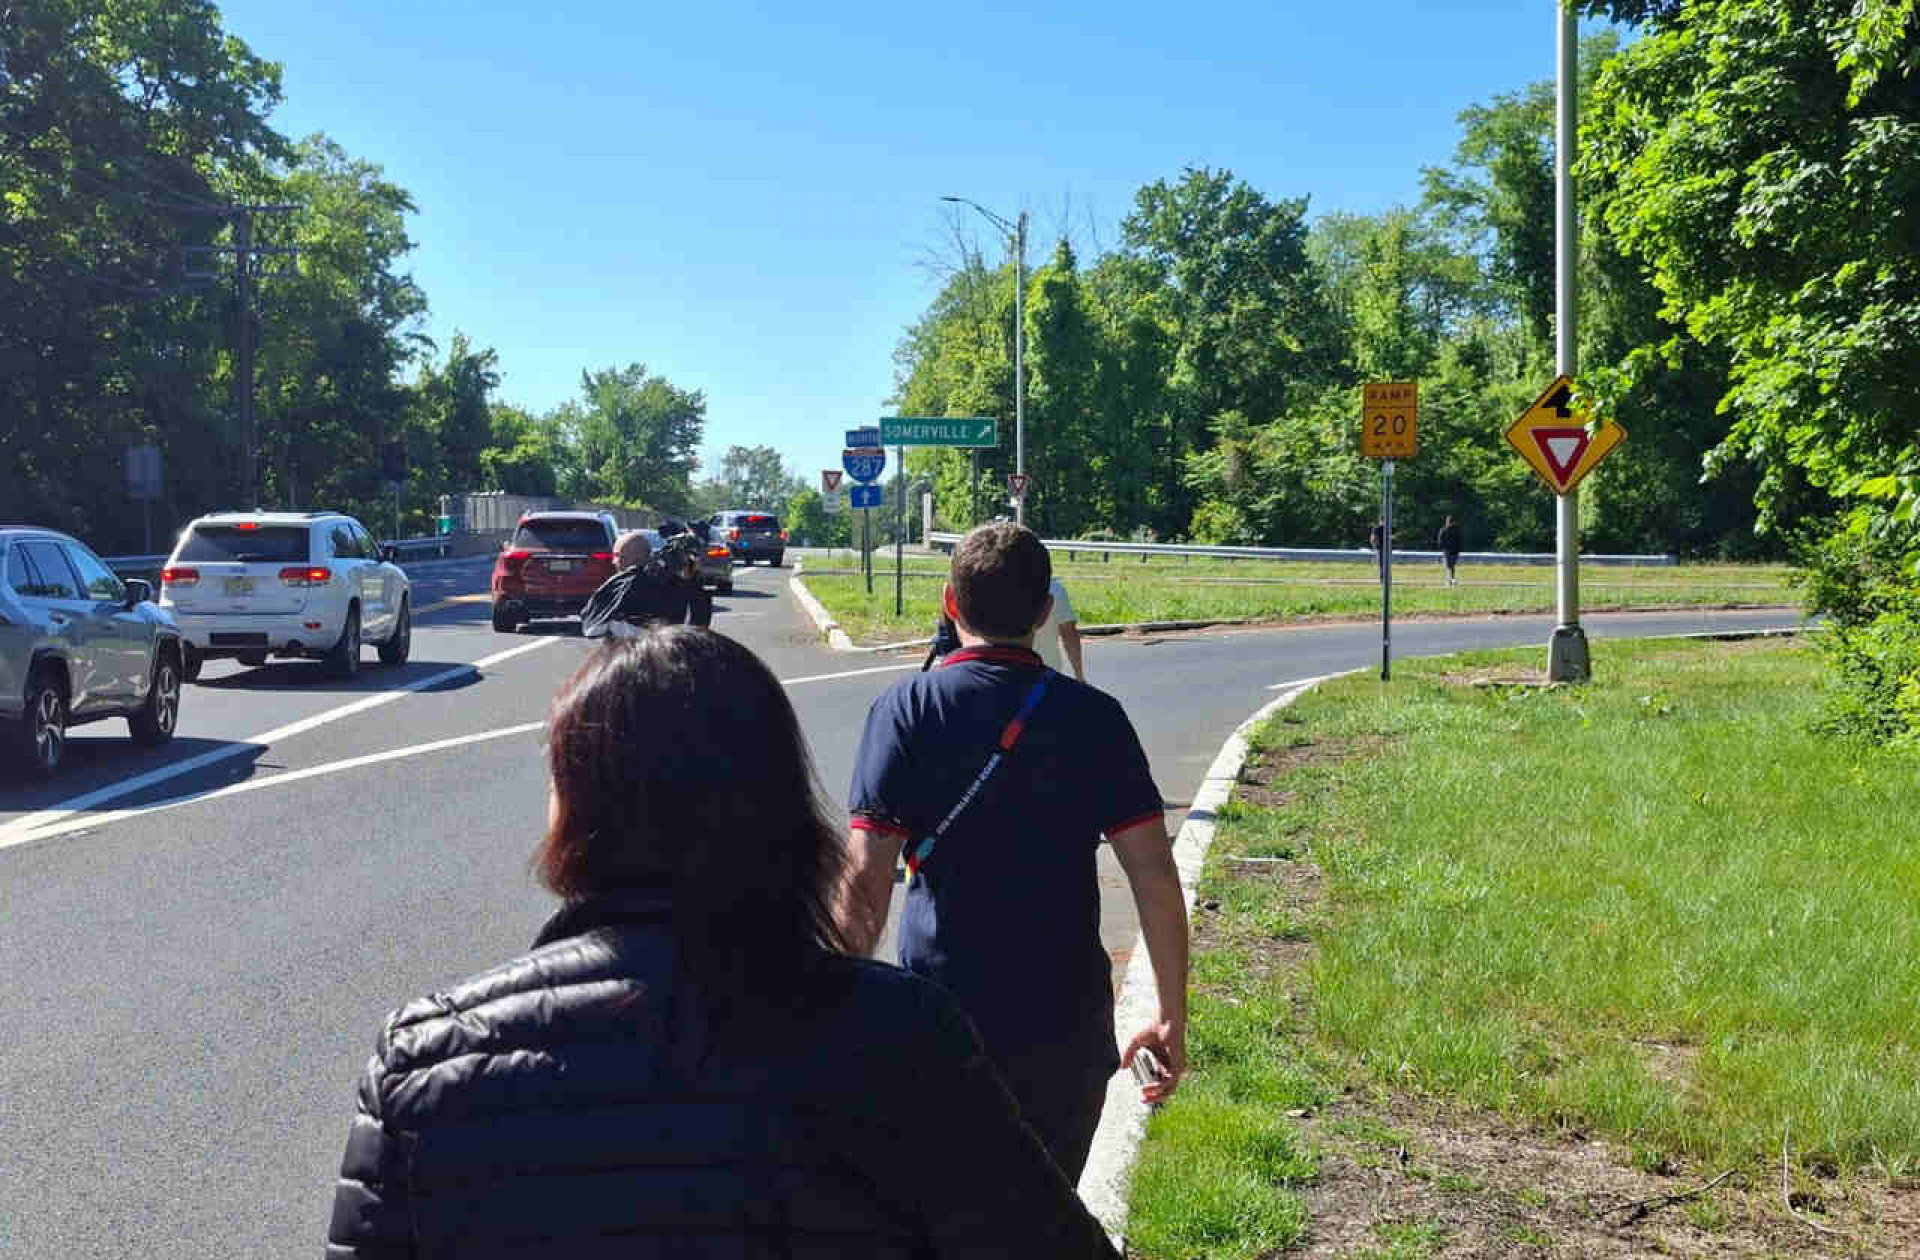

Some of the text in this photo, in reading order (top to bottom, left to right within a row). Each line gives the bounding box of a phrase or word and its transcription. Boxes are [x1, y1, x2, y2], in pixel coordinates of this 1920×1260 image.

[884, 425, 972, 439] SOMERVILLE
[1374, 415, 1405, 435] 20
[852, 457, 882, 476] 287
